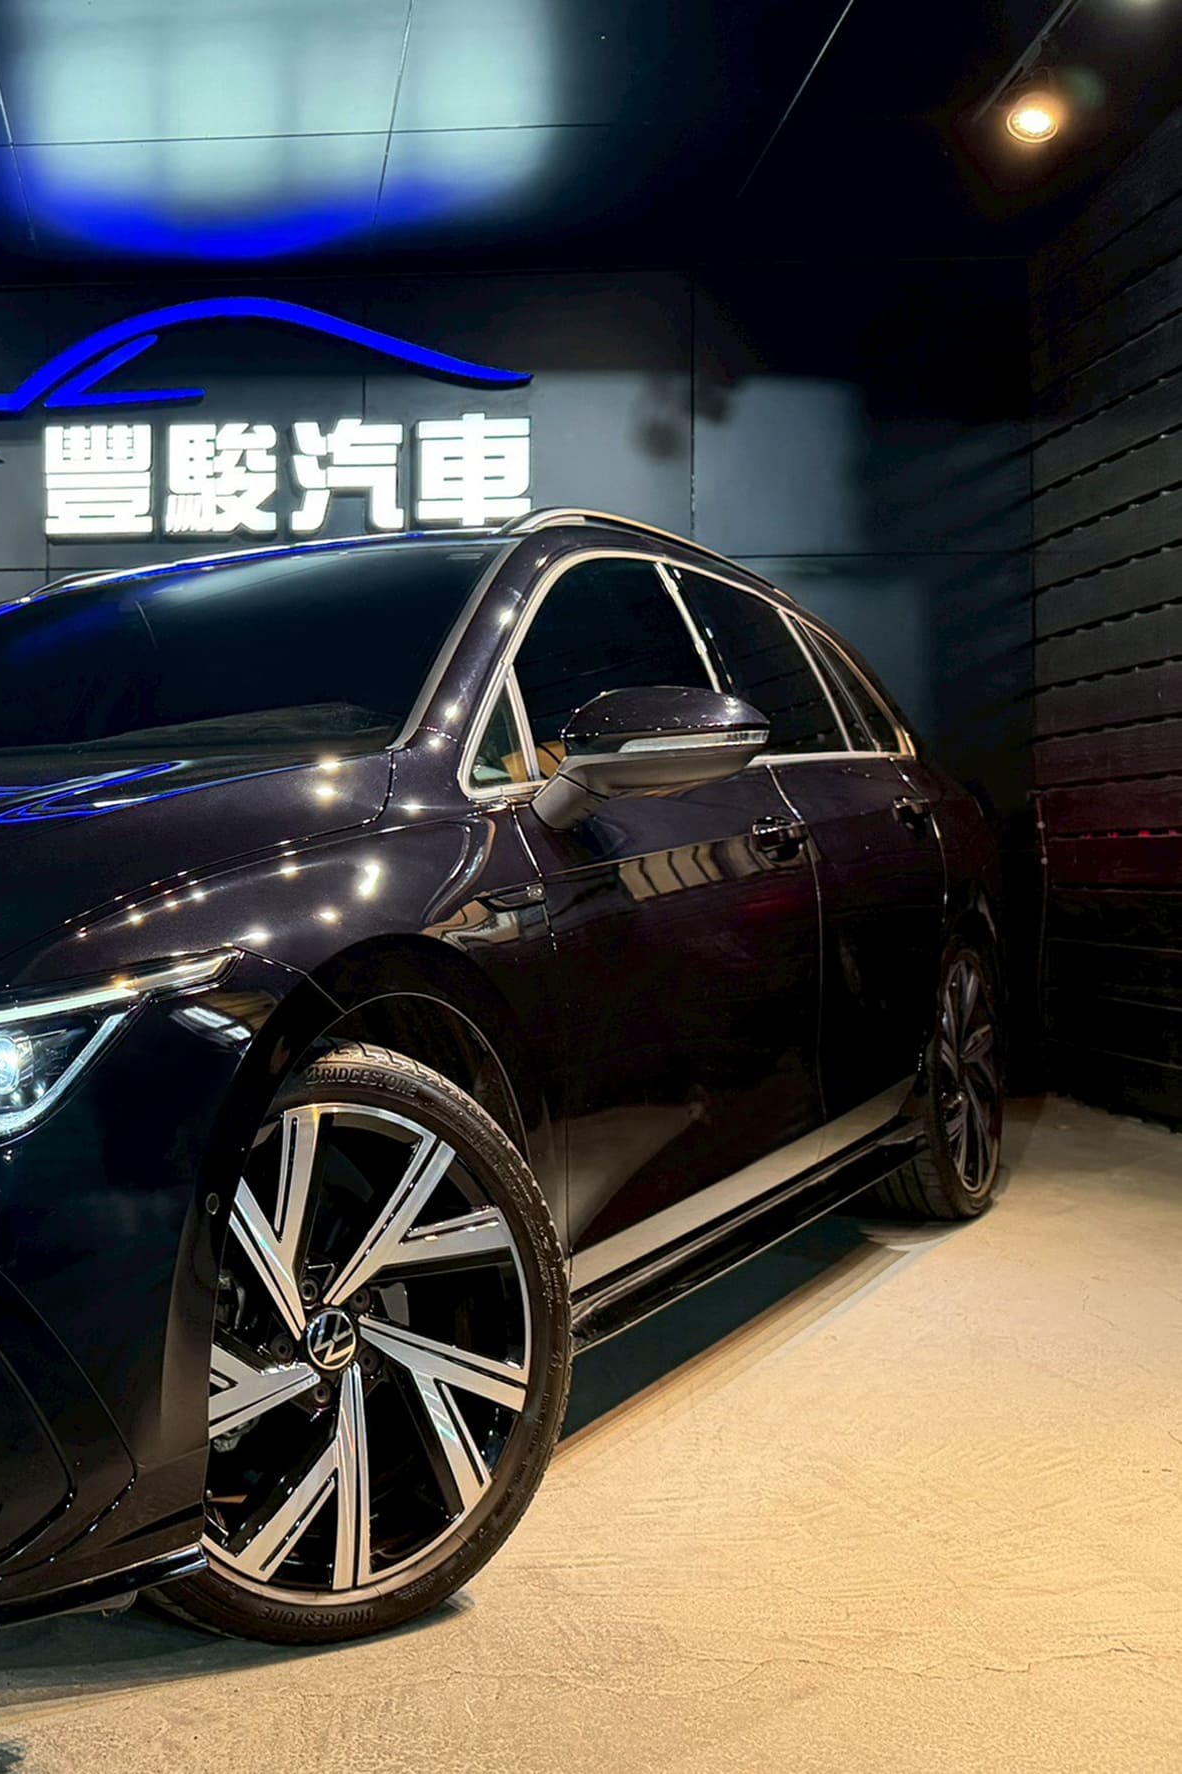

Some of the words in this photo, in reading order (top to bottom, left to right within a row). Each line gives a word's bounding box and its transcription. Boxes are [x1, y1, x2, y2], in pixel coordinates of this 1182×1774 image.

[44, 412, 532, 536] 豐駿汽車
[306, 1065, 420, 1098] BRIDGESTONE
